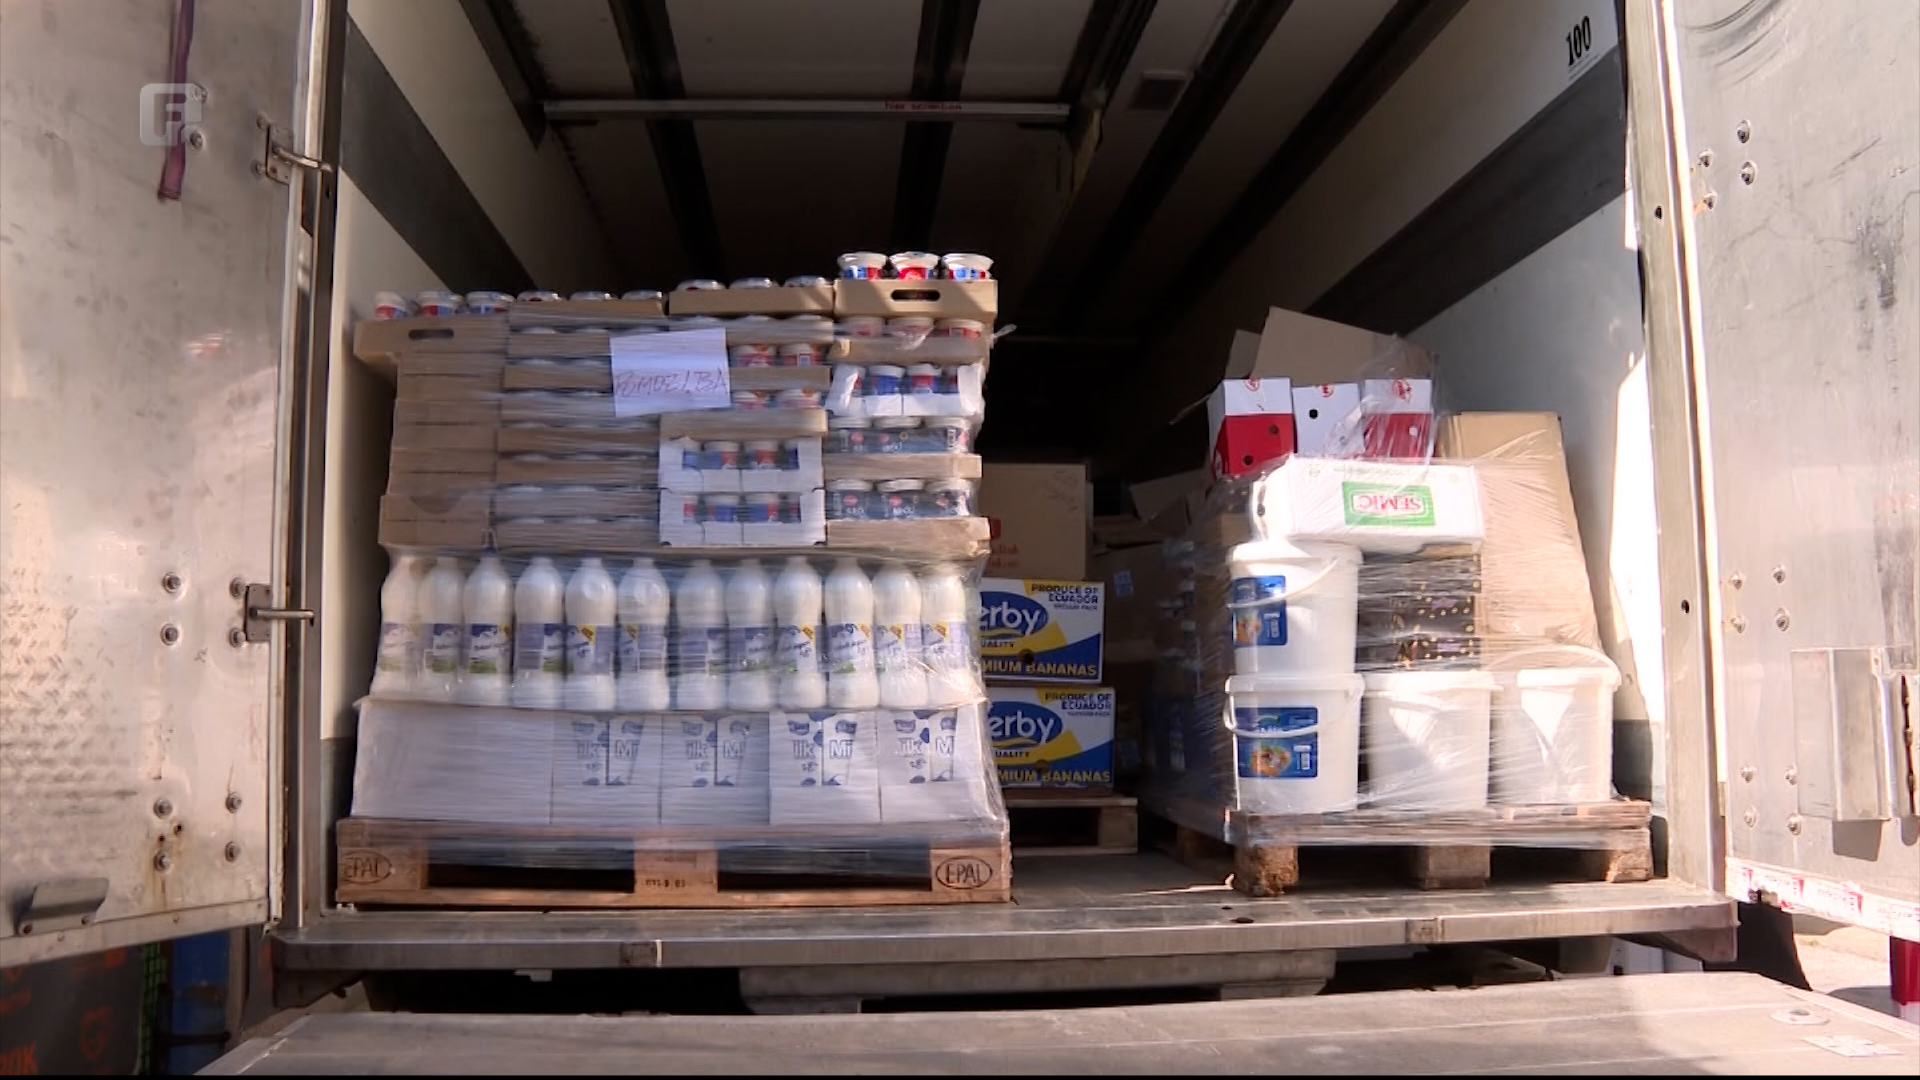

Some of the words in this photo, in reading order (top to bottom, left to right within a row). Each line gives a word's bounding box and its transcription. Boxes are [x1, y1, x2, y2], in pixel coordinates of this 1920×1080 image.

[1566, 15, 1592, 67] 100
[1031, 583, 1082, 595] PRODUCE
[1085, 586, 1099, 595] OF
[1049, 593, 1099, 604] ECUADOR
[1025, 662, 1097, 676] BANANAS
[1061, 700, 1112, 710] ECUADOR
[1041, 770, 1110, 782] BANANAS
